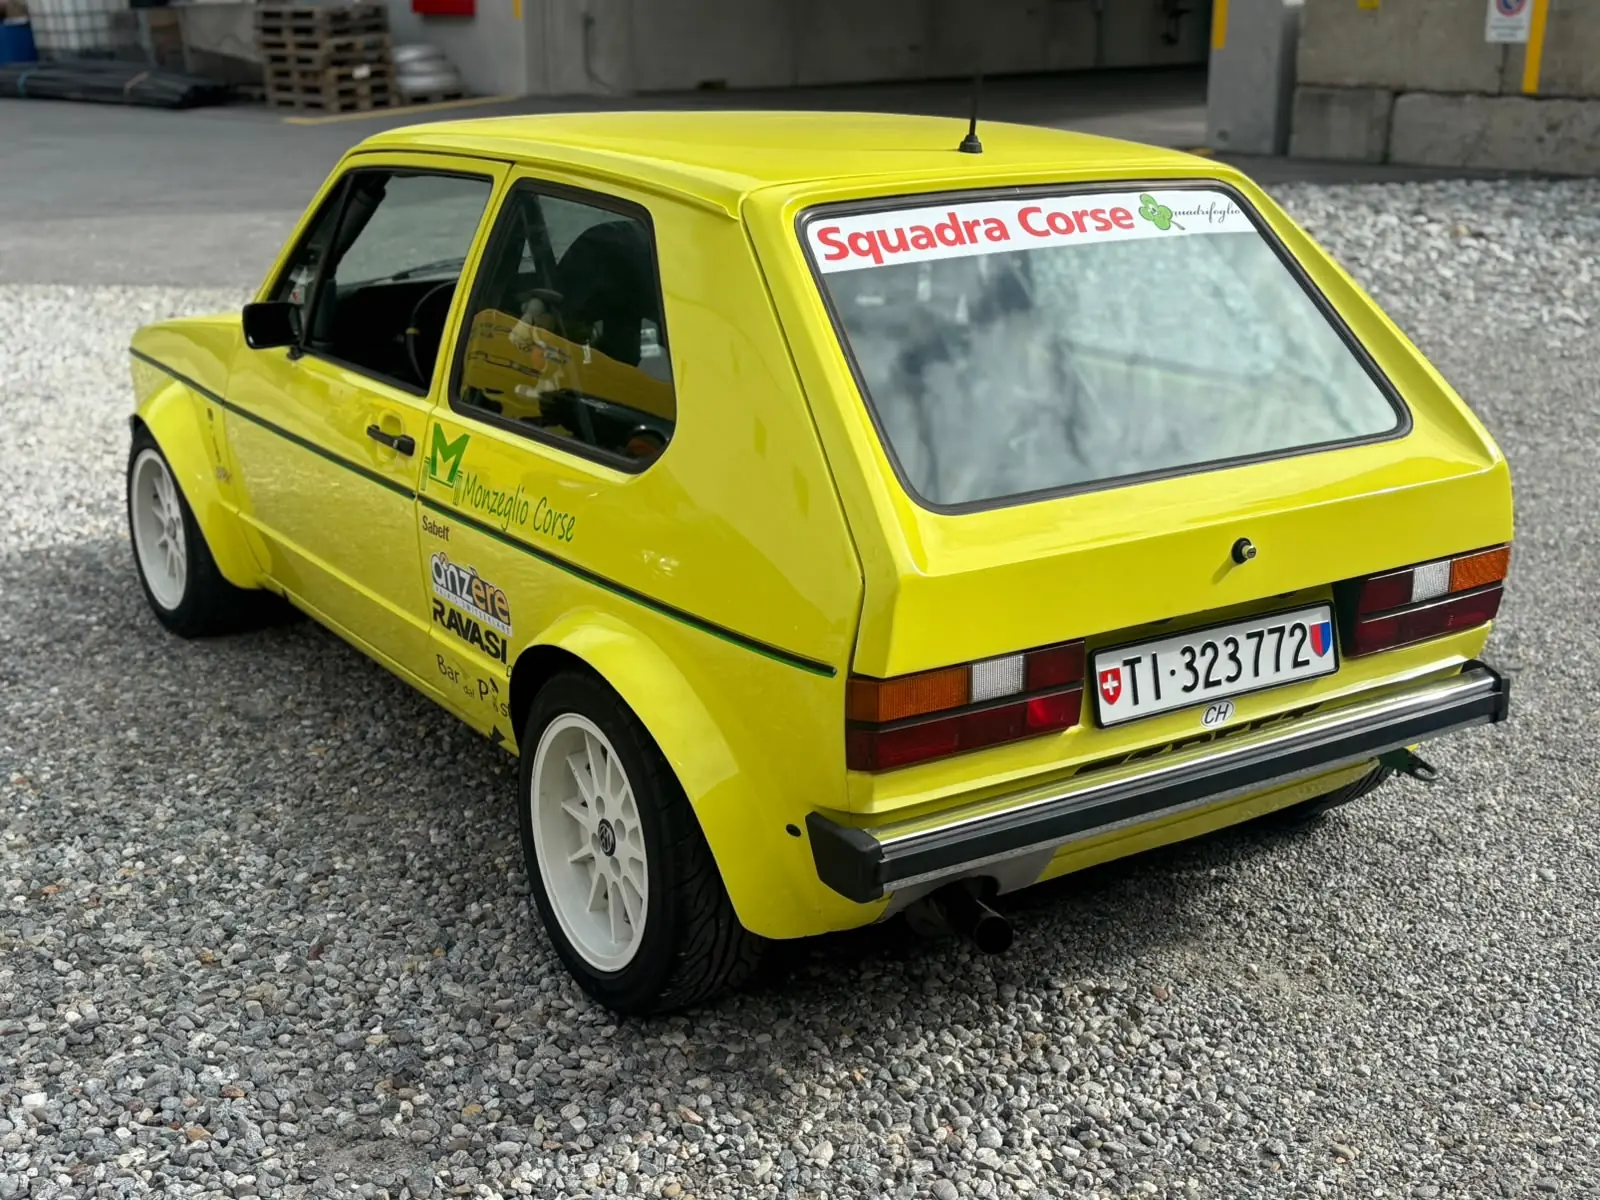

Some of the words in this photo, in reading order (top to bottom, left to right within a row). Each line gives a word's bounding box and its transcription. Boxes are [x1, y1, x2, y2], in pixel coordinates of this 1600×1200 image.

[817, 212, 1010, 264] Squadra
[1017, 206, 1135, 237] Corse
[422, 515, 450, 541] Sabelt
[461, 472, 529, 532] Monzeglio
[533, 496, 576, 543] Corse
[432, 598, 507, 664] RAVASI
[436, 654, 460, 684] Bar
[1204, 705, 1228, 724] CH
